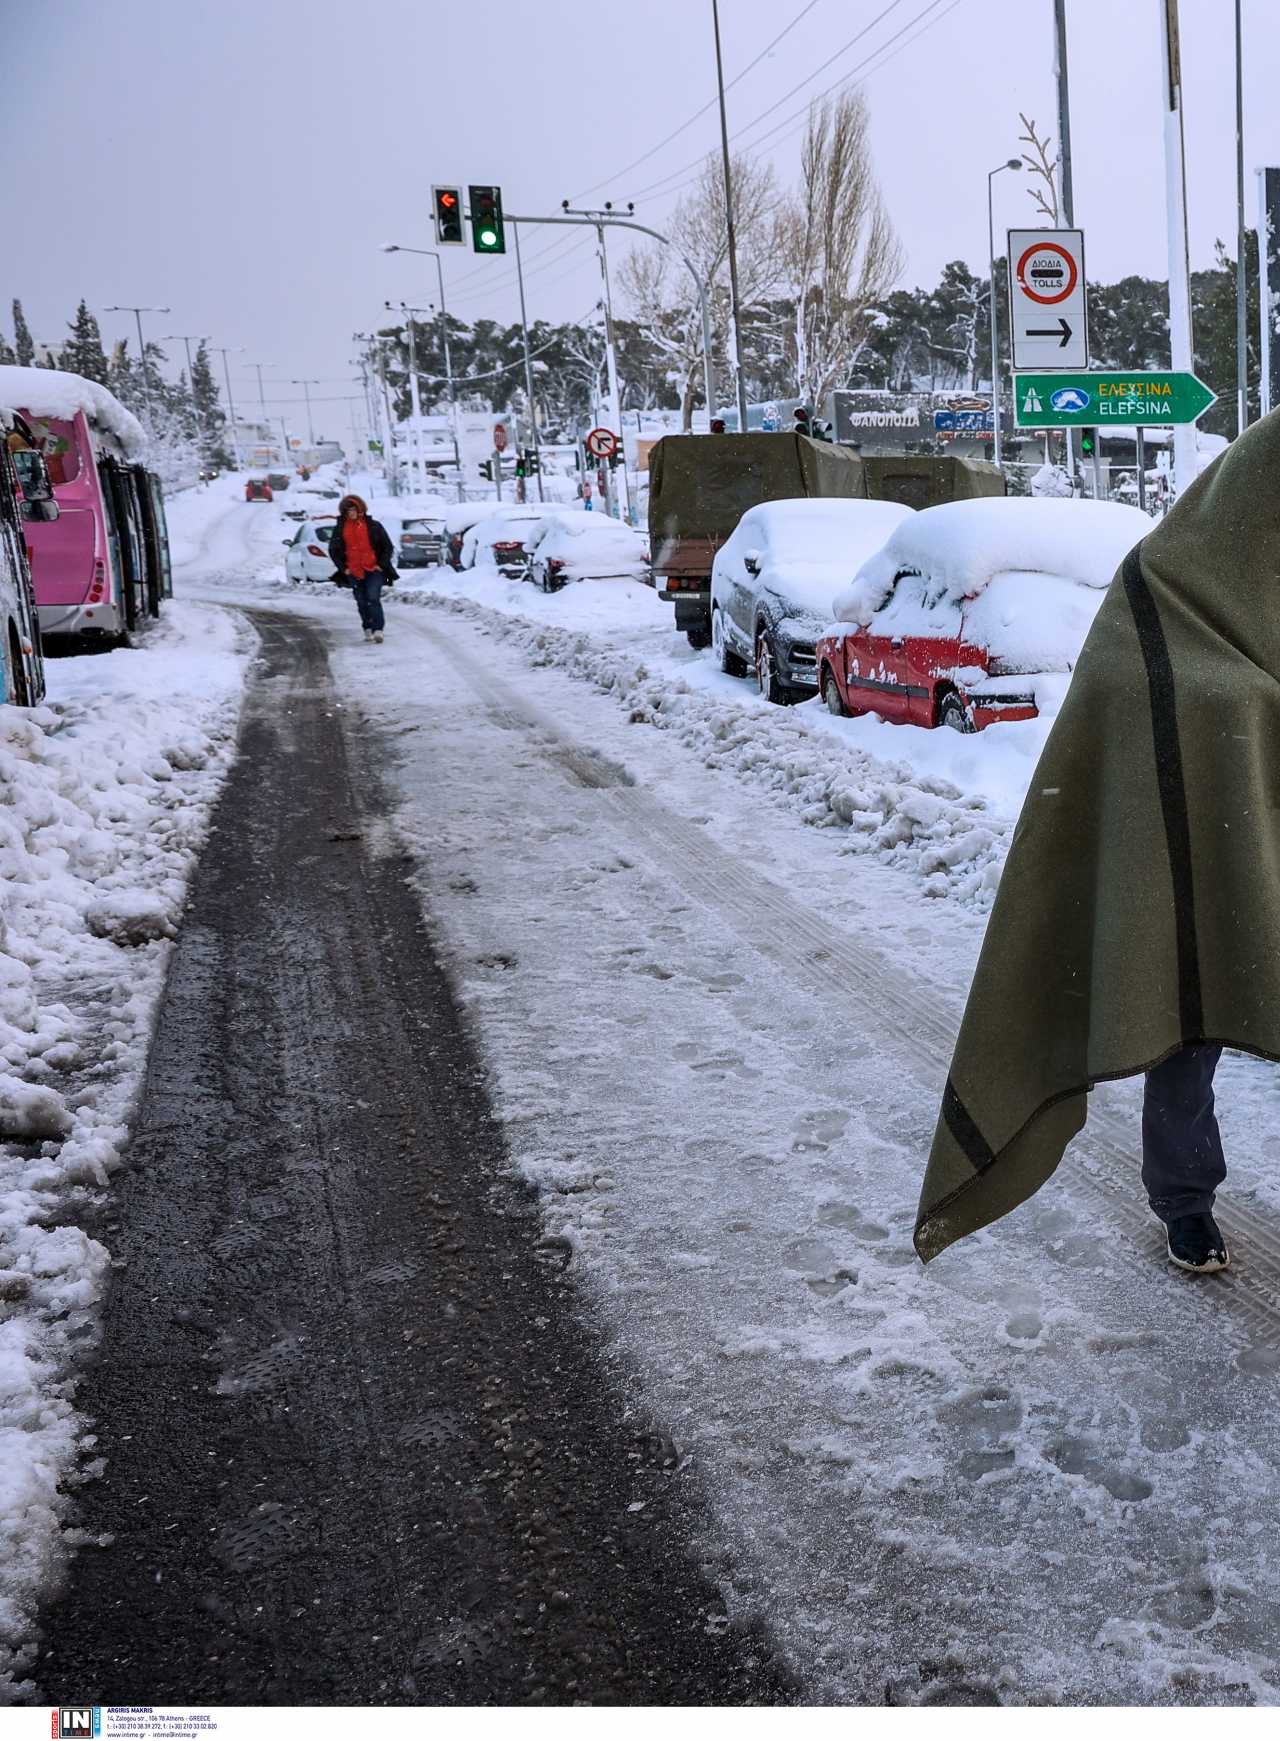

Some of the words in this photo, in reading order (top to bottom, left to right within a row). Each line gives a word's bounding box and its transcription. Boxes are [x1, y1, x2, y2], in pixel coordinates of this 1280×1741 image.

[1032, 259, 1062, 268] ΔΙΟΔΙΑ
[1032, 279, 1063, 288] TOLLS
[1099, 401, 1172, 416] ELEFSINA
